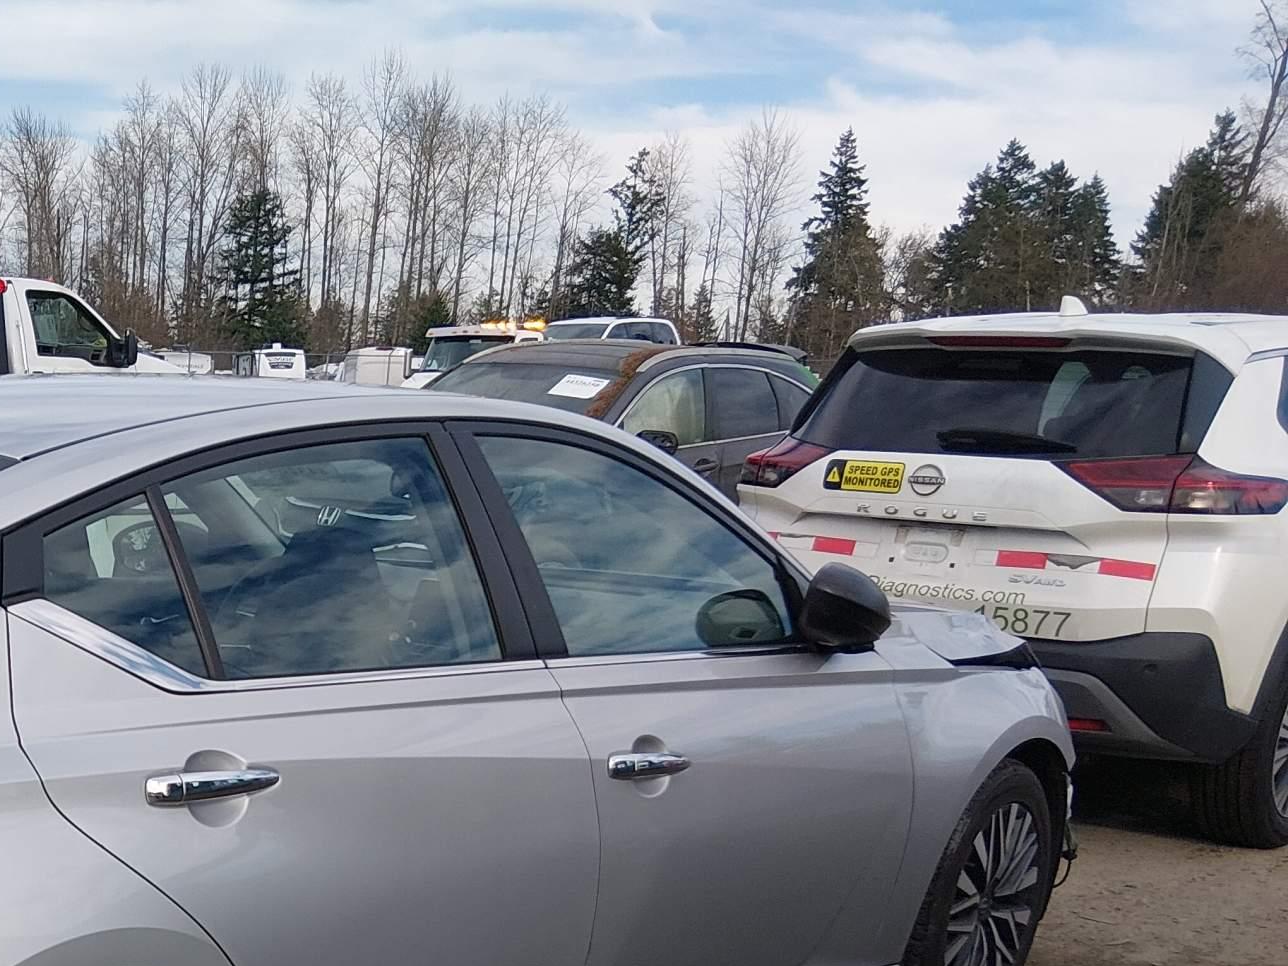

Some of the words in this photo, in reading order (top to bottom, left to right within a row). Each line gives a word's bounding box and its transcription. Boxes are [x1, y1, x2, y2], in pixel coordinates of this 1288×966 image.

[847, 465, 877, 477] SPEED
[880, 466, 900, 477] GPS
[843, 475, 900, 489] MONITORED
[908, 476, 945, 485] NISSAN
[856, 503, 988, 522] ROGUE
